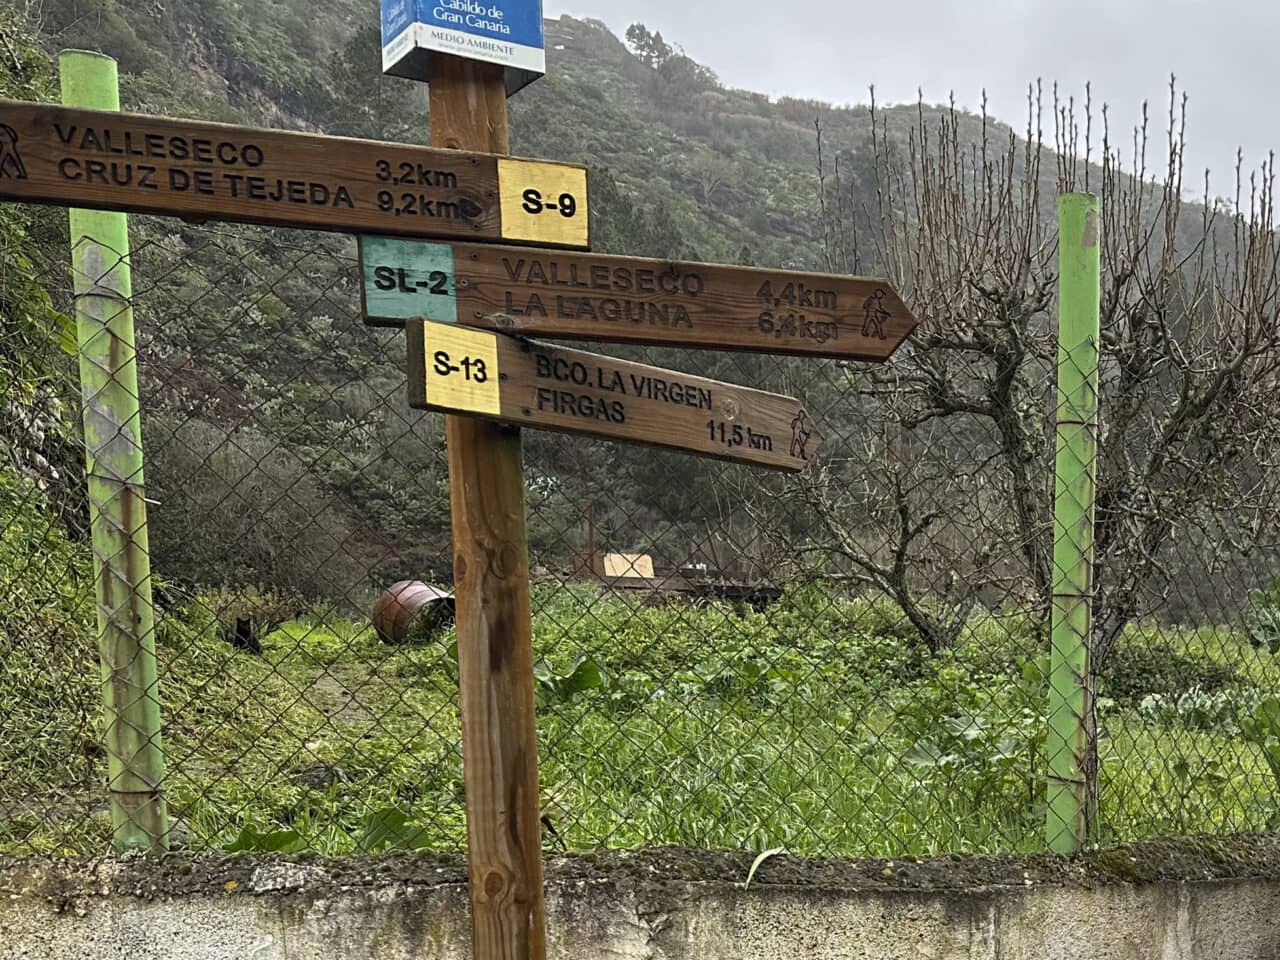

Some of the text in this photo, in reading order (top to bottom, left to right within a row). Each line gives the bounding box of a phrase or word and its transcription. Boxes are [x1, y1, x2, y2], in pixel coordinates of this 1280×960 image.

[433, 7, 511, 34] Gran Canaria
[440, 0, 504, 19] Cabildo de
[431, 30, 465, 45] MEDIO
[466, 38, 514, 56] AMBIENTE
[54, 123, 458, 188] VALLESECO 3,2km
[58, 157, 461, 218] CRUZ DE TEJEDA 9,2km
[522, 189, 577, 218] S-9
[374, 266, 449, 295] SL-2
[502, 257, 838, 310] VALLESECO 4,4km
[505, 290, 548, 317] LA
[556, 294, 693, 329] LAGUNA
[434, 350, 488, 384] S-13
[535, 354, 712, 411] BCO. LA VIRGEN
[536, 387, 625, 424] FIRGAS
